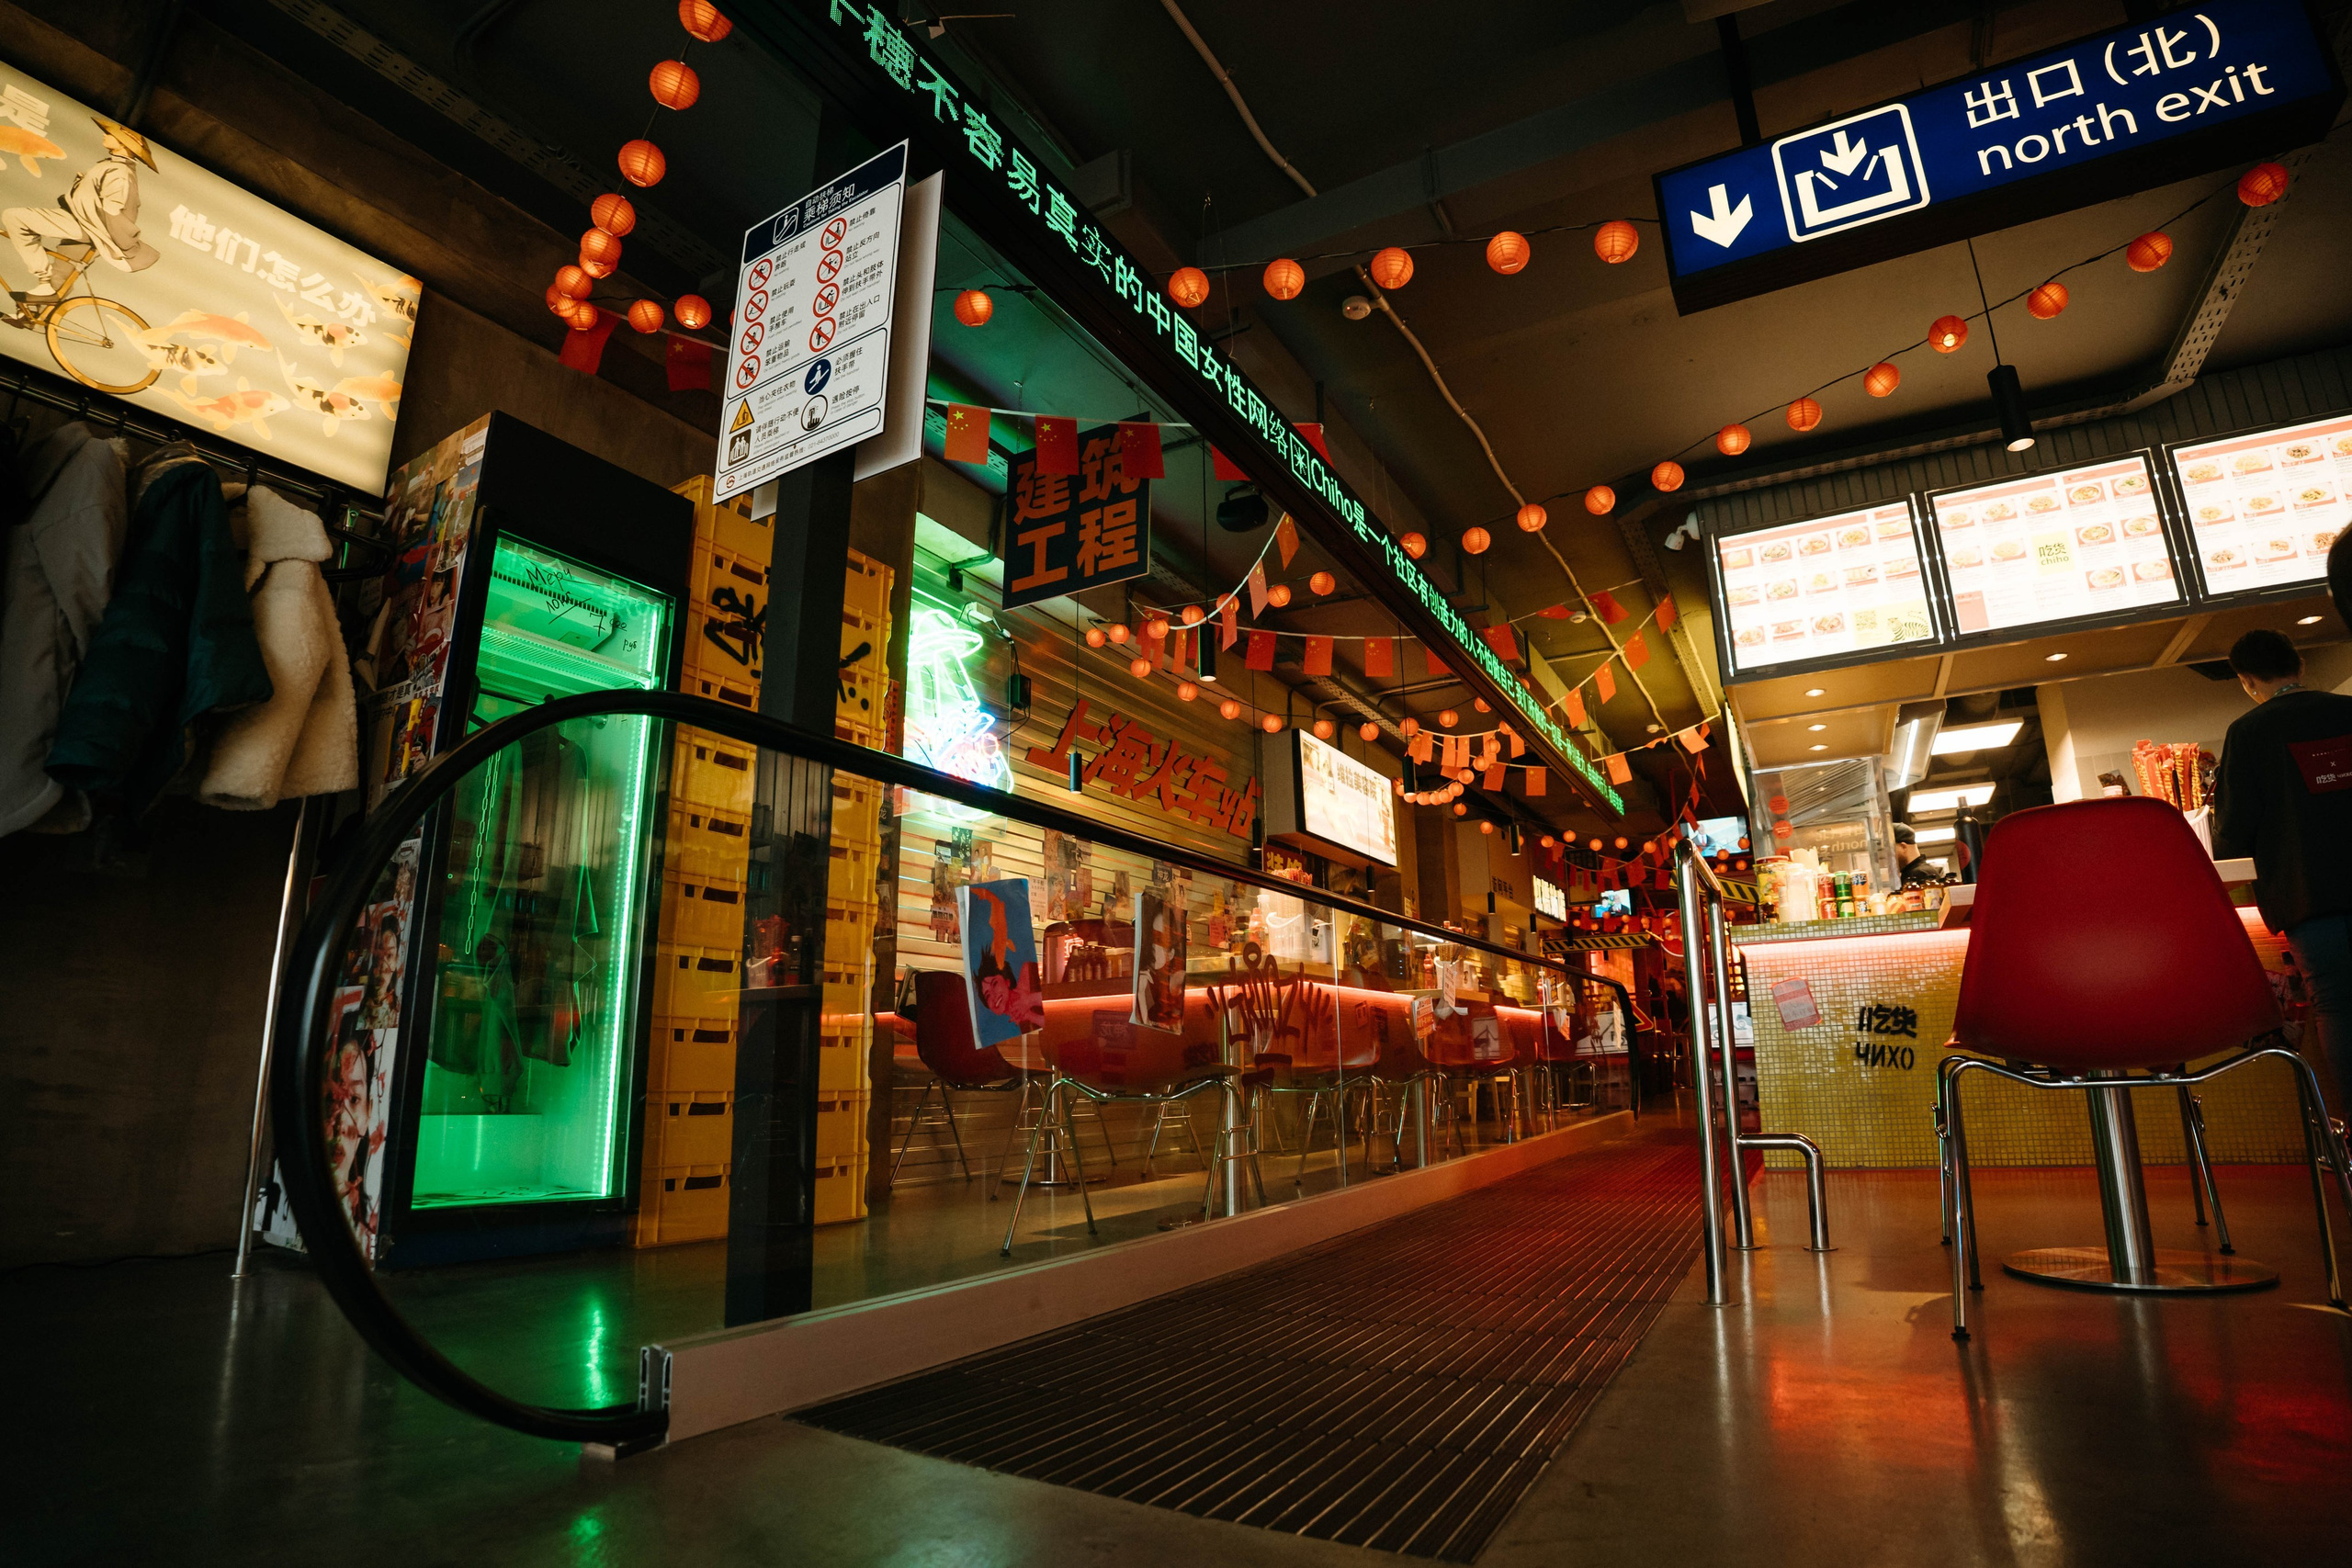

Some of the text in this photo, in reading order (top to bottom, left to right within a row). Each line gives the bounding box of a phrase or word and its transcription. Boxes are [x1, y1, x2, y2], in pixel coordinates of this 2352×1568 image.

[1975, 62, 2276, 177] north exit
[802, 183, 855, 224] 乘梯须知
[169, 204, 377, 329] 他们怎么办
[839, 295, 880, 321] 禁止在出入口
[1012, 499, 1138, 592] 工程
[2039, 542, 2068, 558] 吃货
[2041, 555, 2070, 567] chiho
[1025, 698, 1263, 838] 上海火车站
[2315, 773, 2337, 784] 吃货
[1858, 1003, 1917, 1039] 吃货
[1856, 1041, 1915, 1071] ЧИХО
